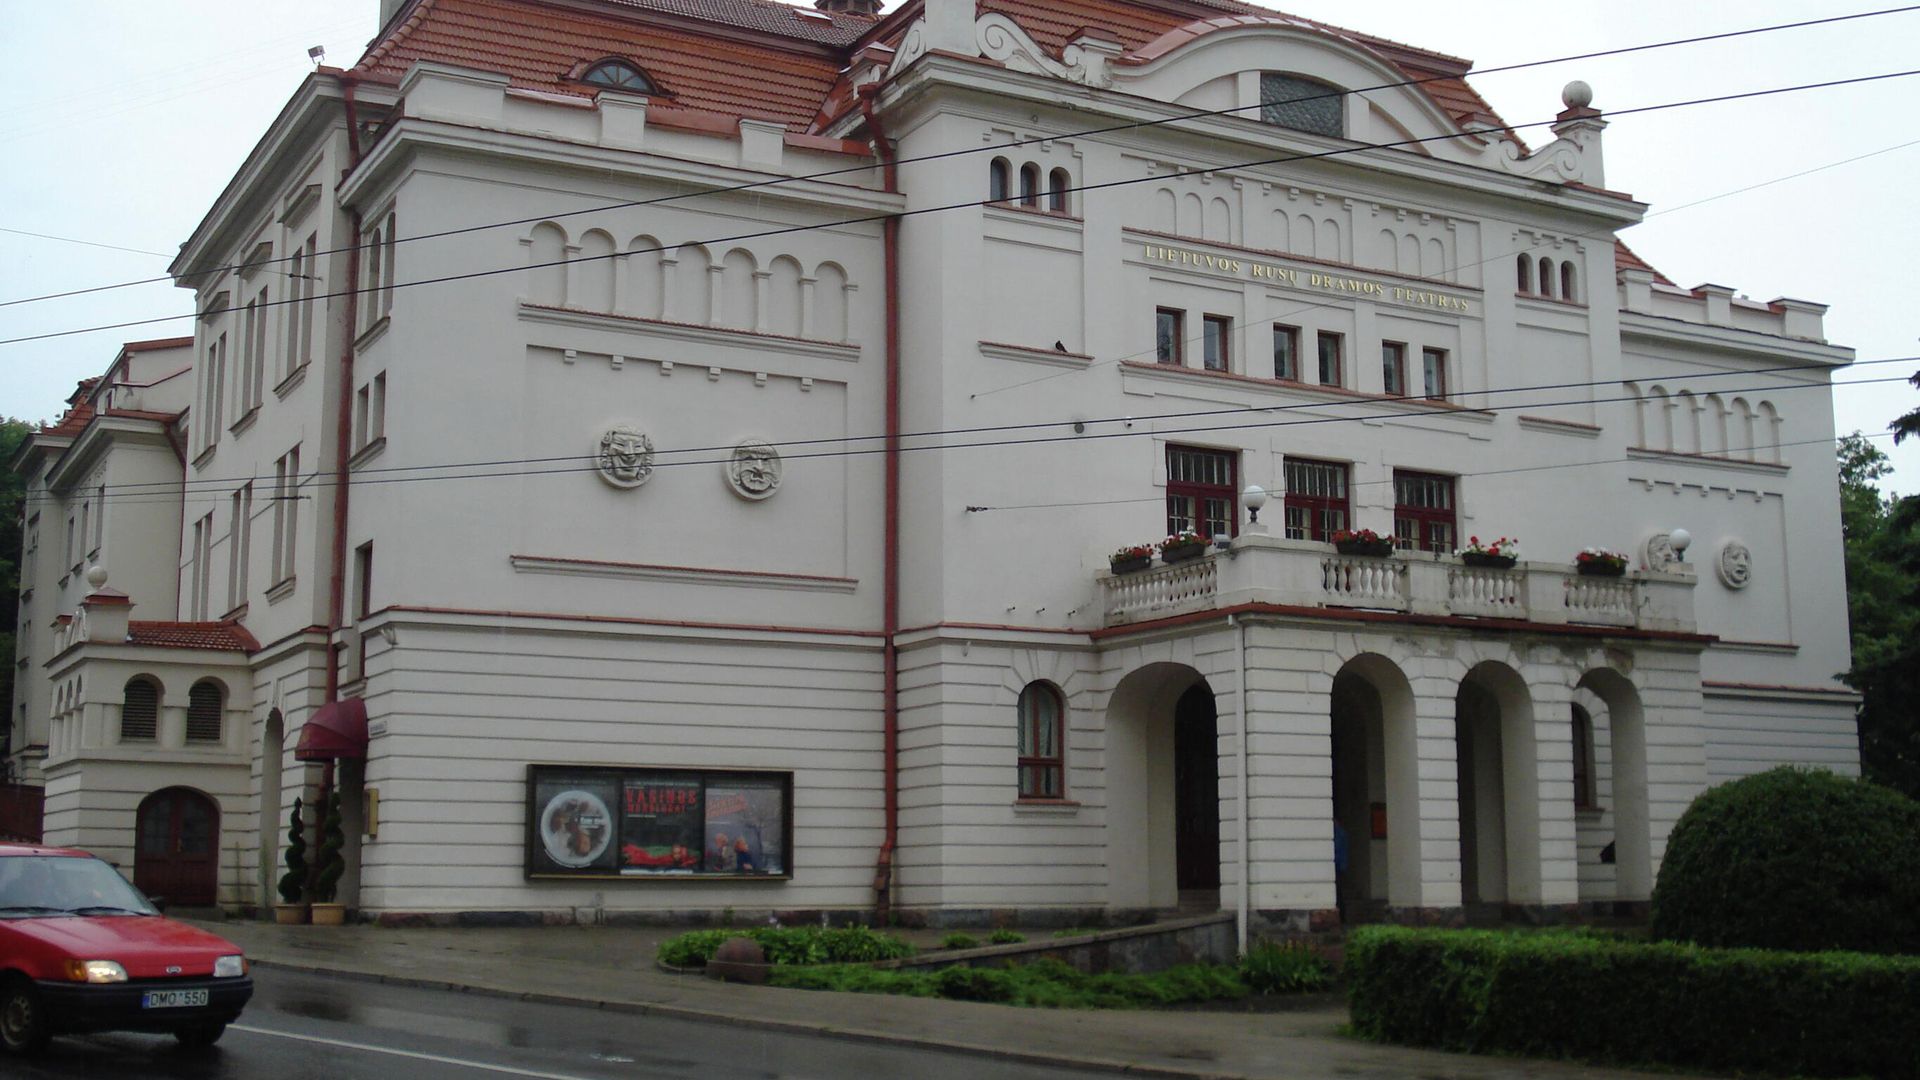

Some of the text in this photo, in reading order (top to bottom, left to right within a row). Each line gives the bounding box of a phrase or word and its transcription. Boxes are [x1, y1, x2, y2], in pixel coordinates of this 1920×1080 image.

[1144, 245, 1470, 312] LIETUVOS RUSŲ DRAMOS TEATRAS
[150, 991, 207, 1006] DMO 550
